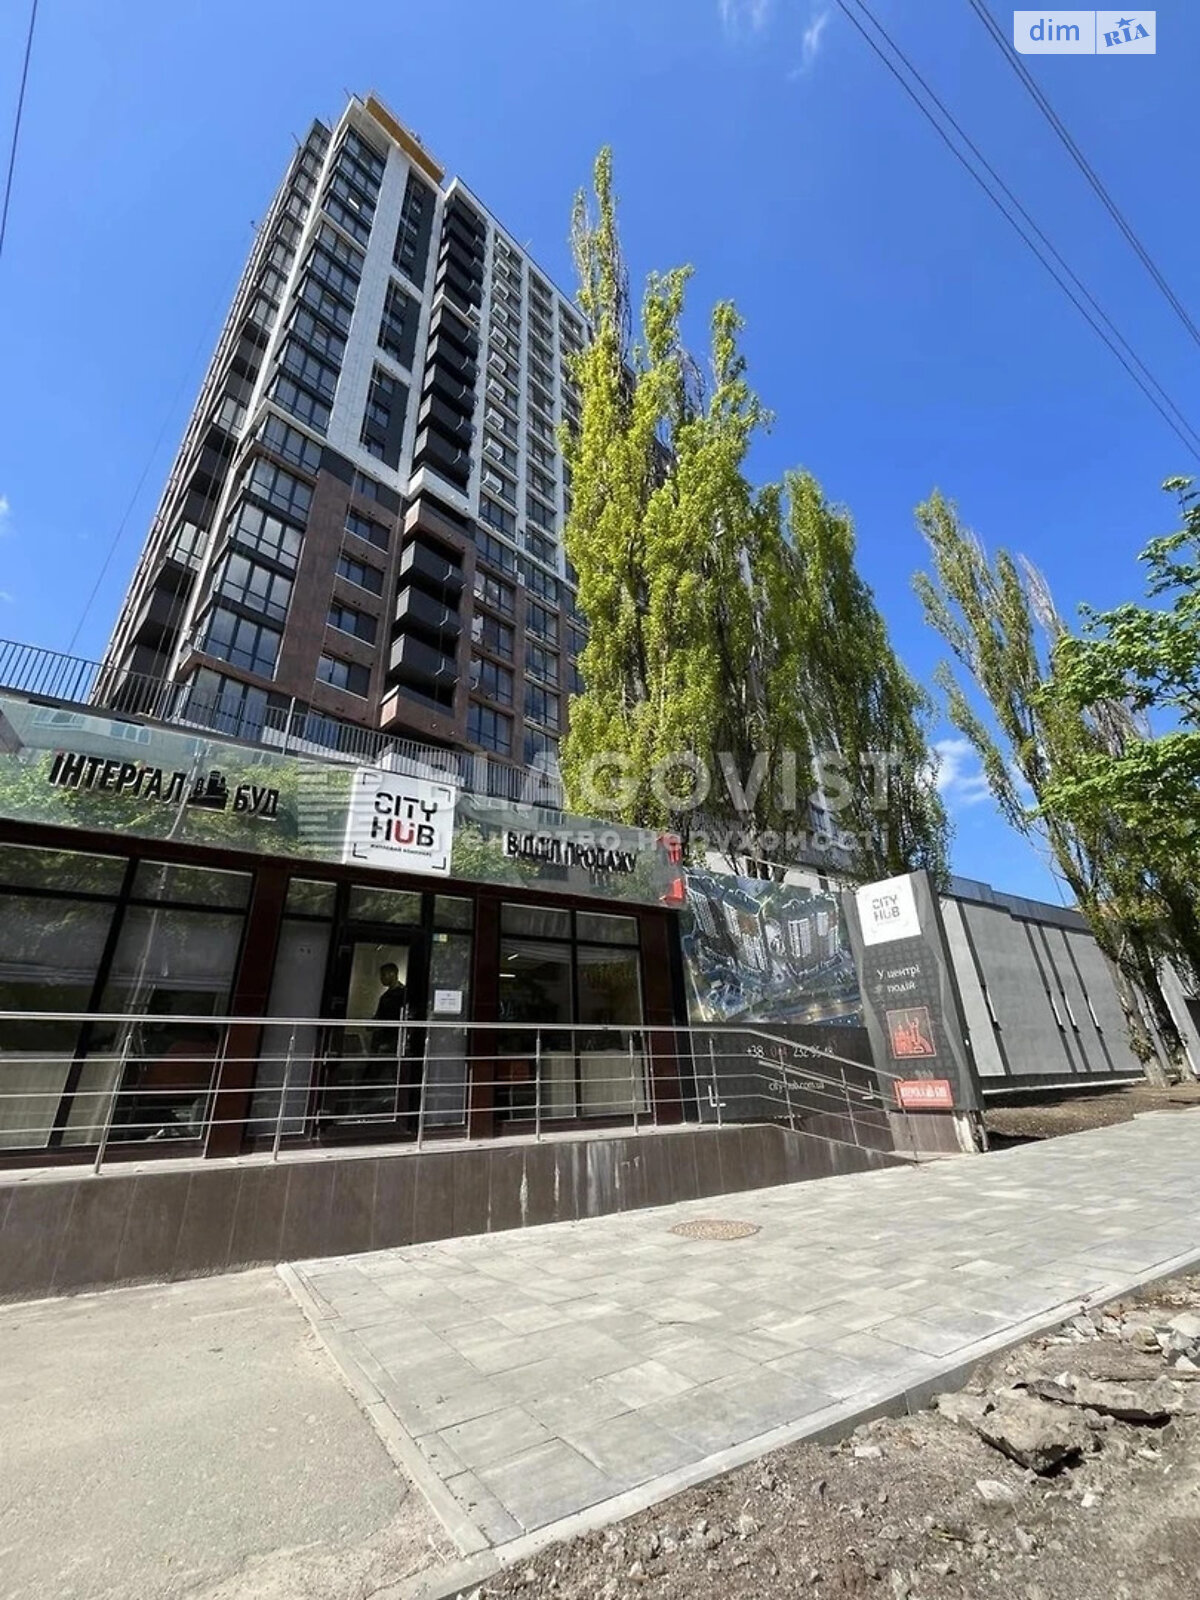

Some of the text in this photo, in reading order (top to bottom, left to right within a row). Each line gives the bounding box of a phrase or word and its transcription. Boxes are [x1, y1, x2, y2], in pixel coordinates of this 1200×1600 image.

[234, 785, 280, 821] БУД
[374, 792, 438, 822] CITY
[371, 816, 435, 847] HUB
[872, 895, 897, 909] CITY
[873, 906, 900, 921] HUB
